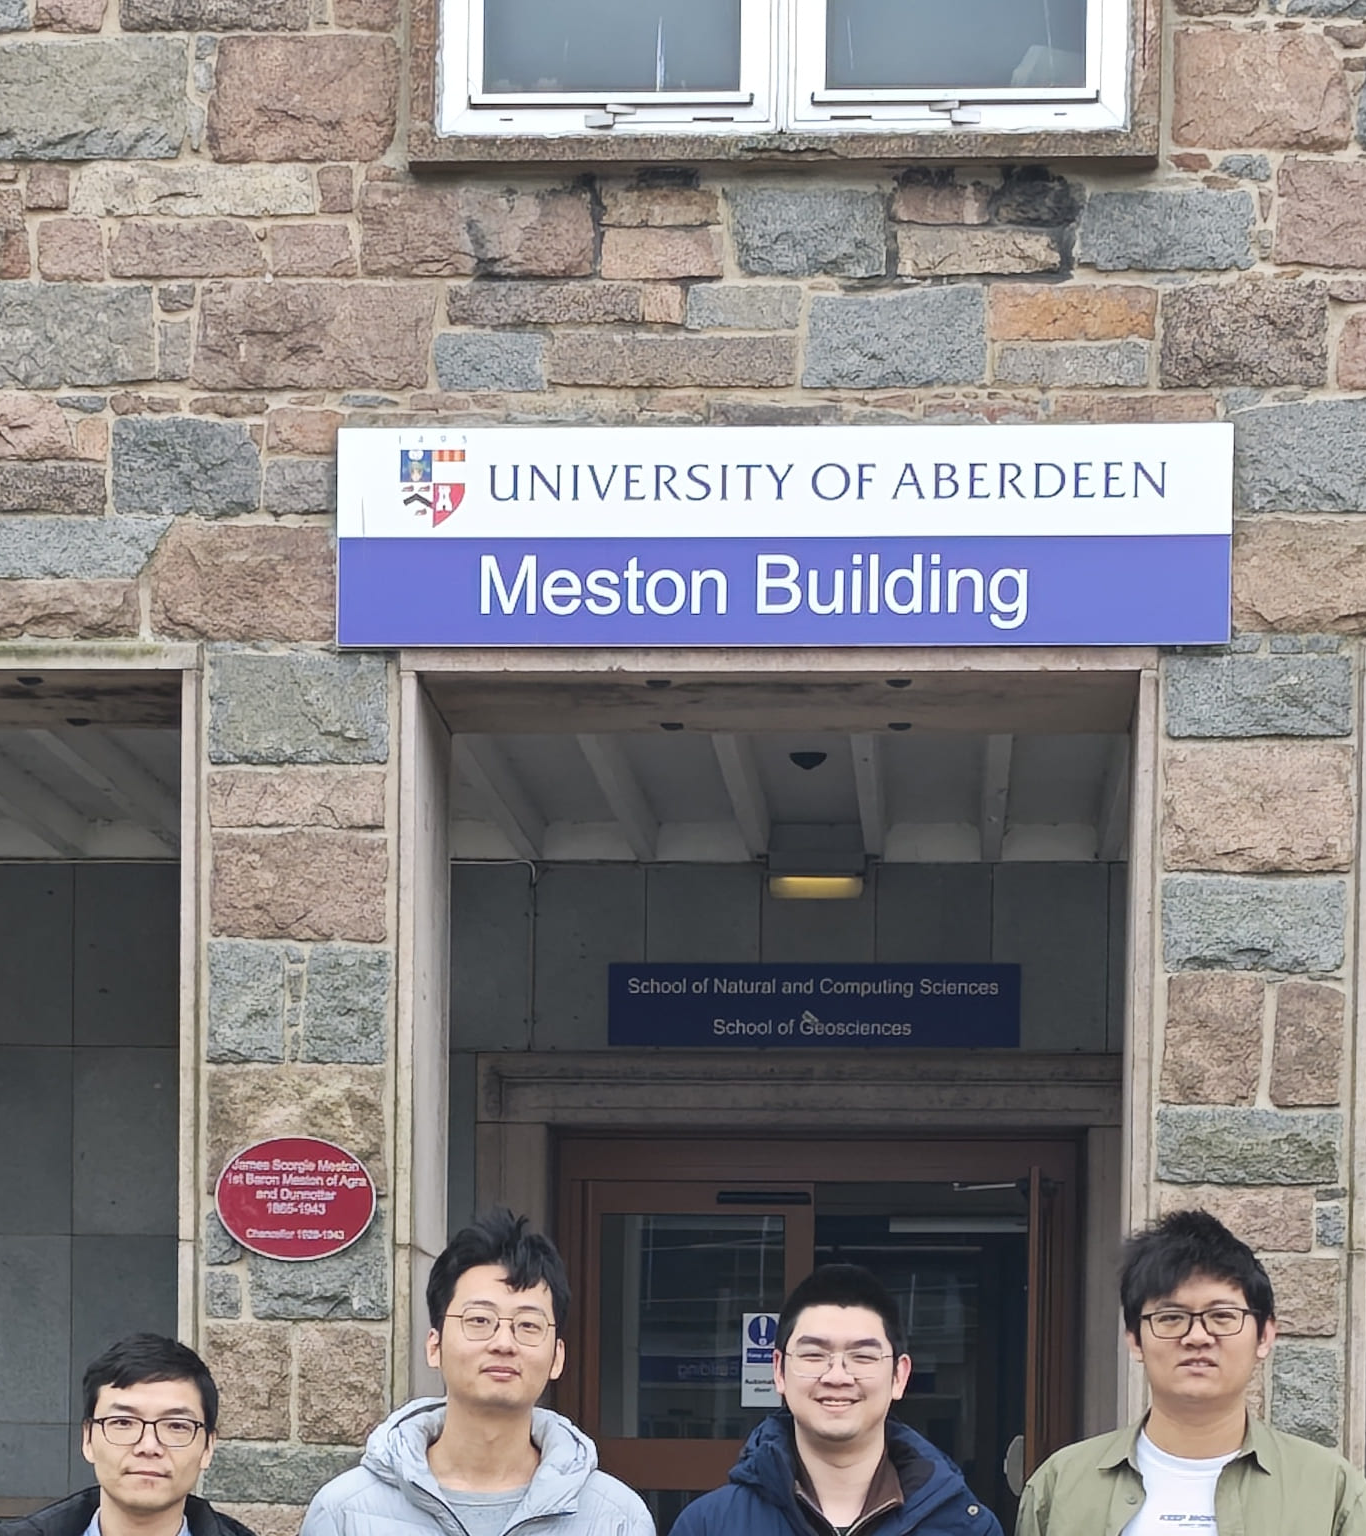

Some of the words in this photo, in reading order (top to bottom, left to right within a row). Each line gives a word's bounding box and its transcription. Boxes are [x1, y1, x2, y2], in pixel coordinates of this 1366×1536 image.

[489, 463, 795, 502] UNIVERSITY
[810, 462, 877, 501] OF
[891, 461, 1167, 500] ABERDEEN
[480, 553, 729, 616] Meston
[756, 552, 1029, 631] Building
[628, 977, 686, 995] School
[692, 978, 710, 995] of
[713, 978, 777, 995] Natural
[781, 978, 815, 995] and
[819, 978, 914, 999] Computing
[920, 978, 999, 996] Sciences
[713, 1018, 773, 1036] School
[777, 1019, 796, 1036] of
[799, 1019, 913, 1037] Geosciences
[317, 1160, 360, 1173] Meston
[245, 1172, 280, 1186] Baron
[326, 1174, 338, 1187] of
[256, 1188, 278, 1200] and
